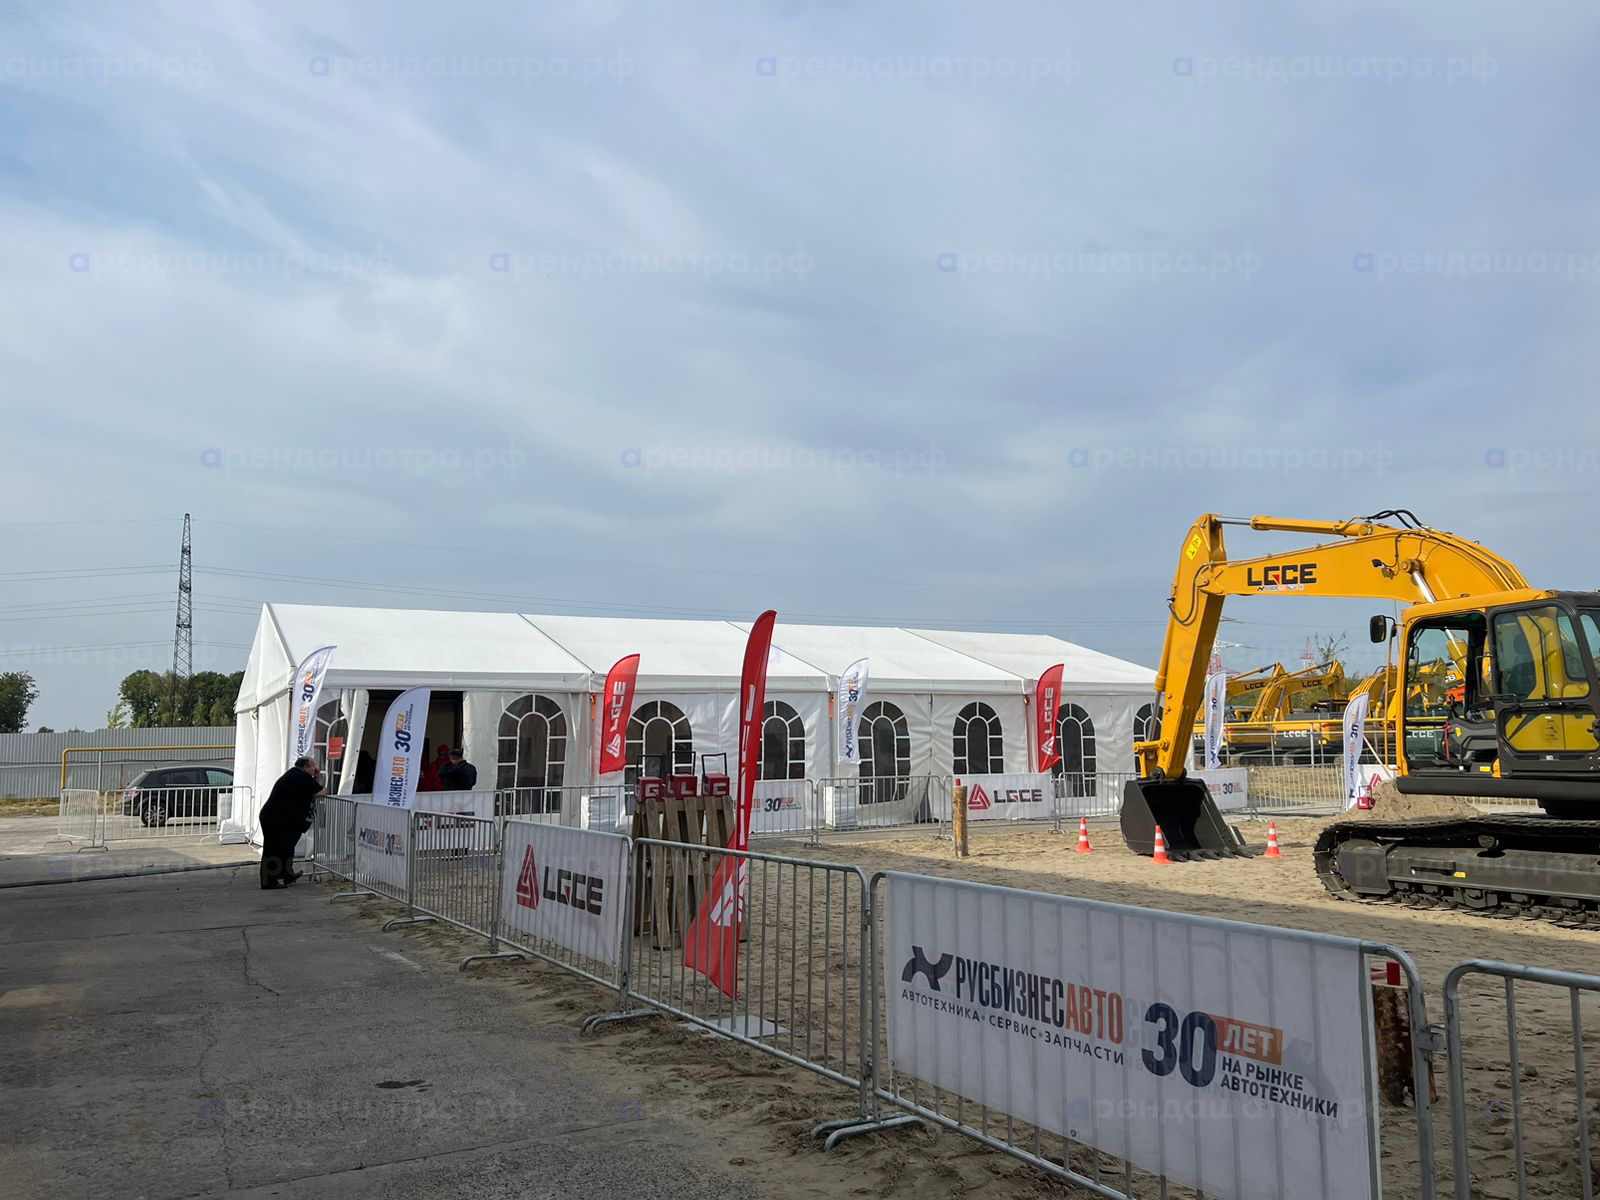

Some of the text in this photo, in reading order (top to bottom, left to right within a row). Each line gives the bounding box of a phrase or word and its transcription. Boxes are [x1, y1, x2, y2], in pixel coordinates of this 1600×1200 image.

[1248, 563, 1317, 587] LGCE
[302, 683, 315, 702] 30
[610, 681, 626, 733] LGCE
[1044, 687, 1054, 735] LGCE
[394, 731, 411, 752] 30
[764, 797, 781, 812] 30
[993, 789, 1043, 803] LGCE
[1222, 782, 1233, 795] 30
[543, 865, 604, 916] LGCE
[956, 955, 1124, 1045] РУСБИЗНЕСАВТО
[902, 988, 1125, 1066] АВТОТЕХНИКА СЕРВИС ЗАПЧАСТИ
[1142, 1002, 1275, 1088] 30 ЛЕТ
[1222, 1056, 1303, 1092] НА РЫНКЕ
[1220, 1075, 1338, 1119] АВТОТЕХНИКИ
